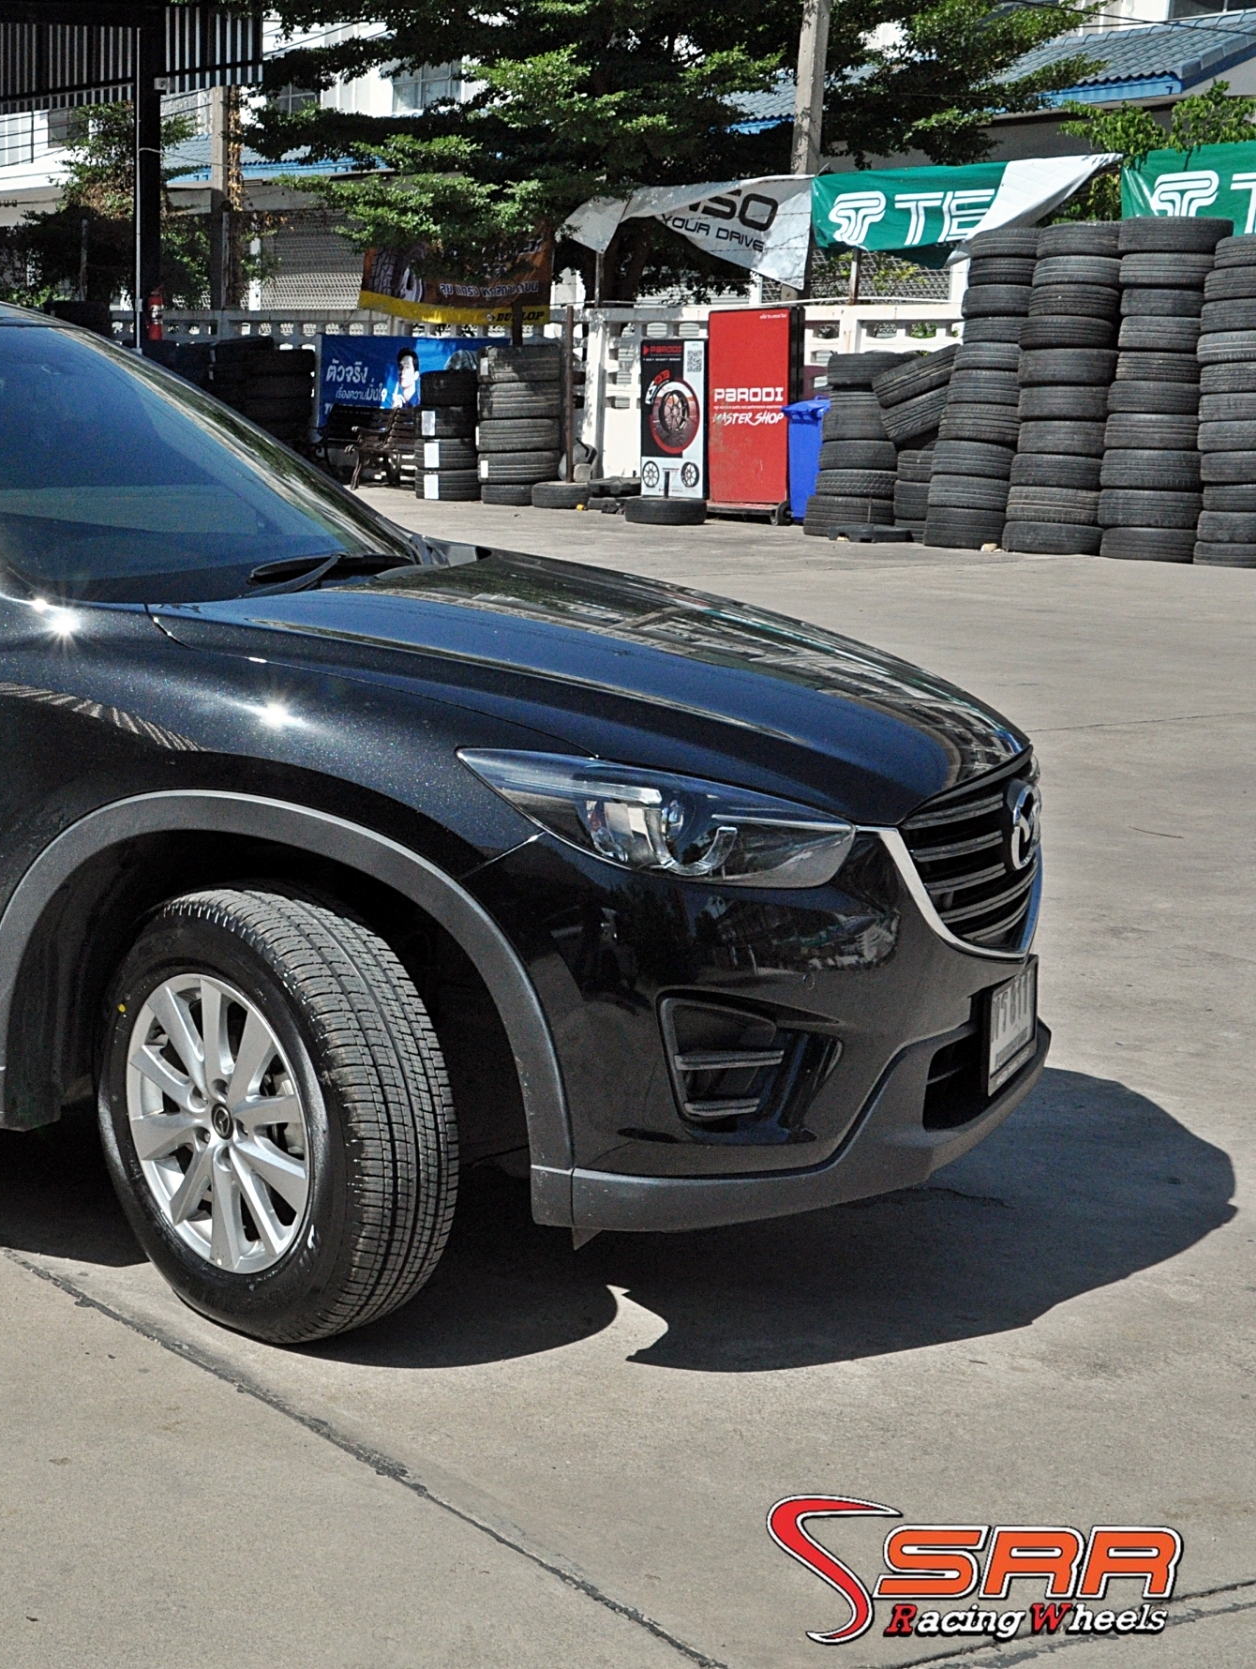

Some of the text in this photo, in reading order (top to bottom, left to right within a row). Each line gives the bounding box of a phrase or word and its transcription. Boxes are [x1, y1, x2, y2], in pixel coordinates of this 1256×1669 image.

[688, 188, 779, 232] SO
[662, 213, 765, 253] YOUR DRIVE
[495, 311, 545, 322] DULOP
[326, 358, 370, 384] ตัวจริง
[753, 410, 785, 425] SHOP
